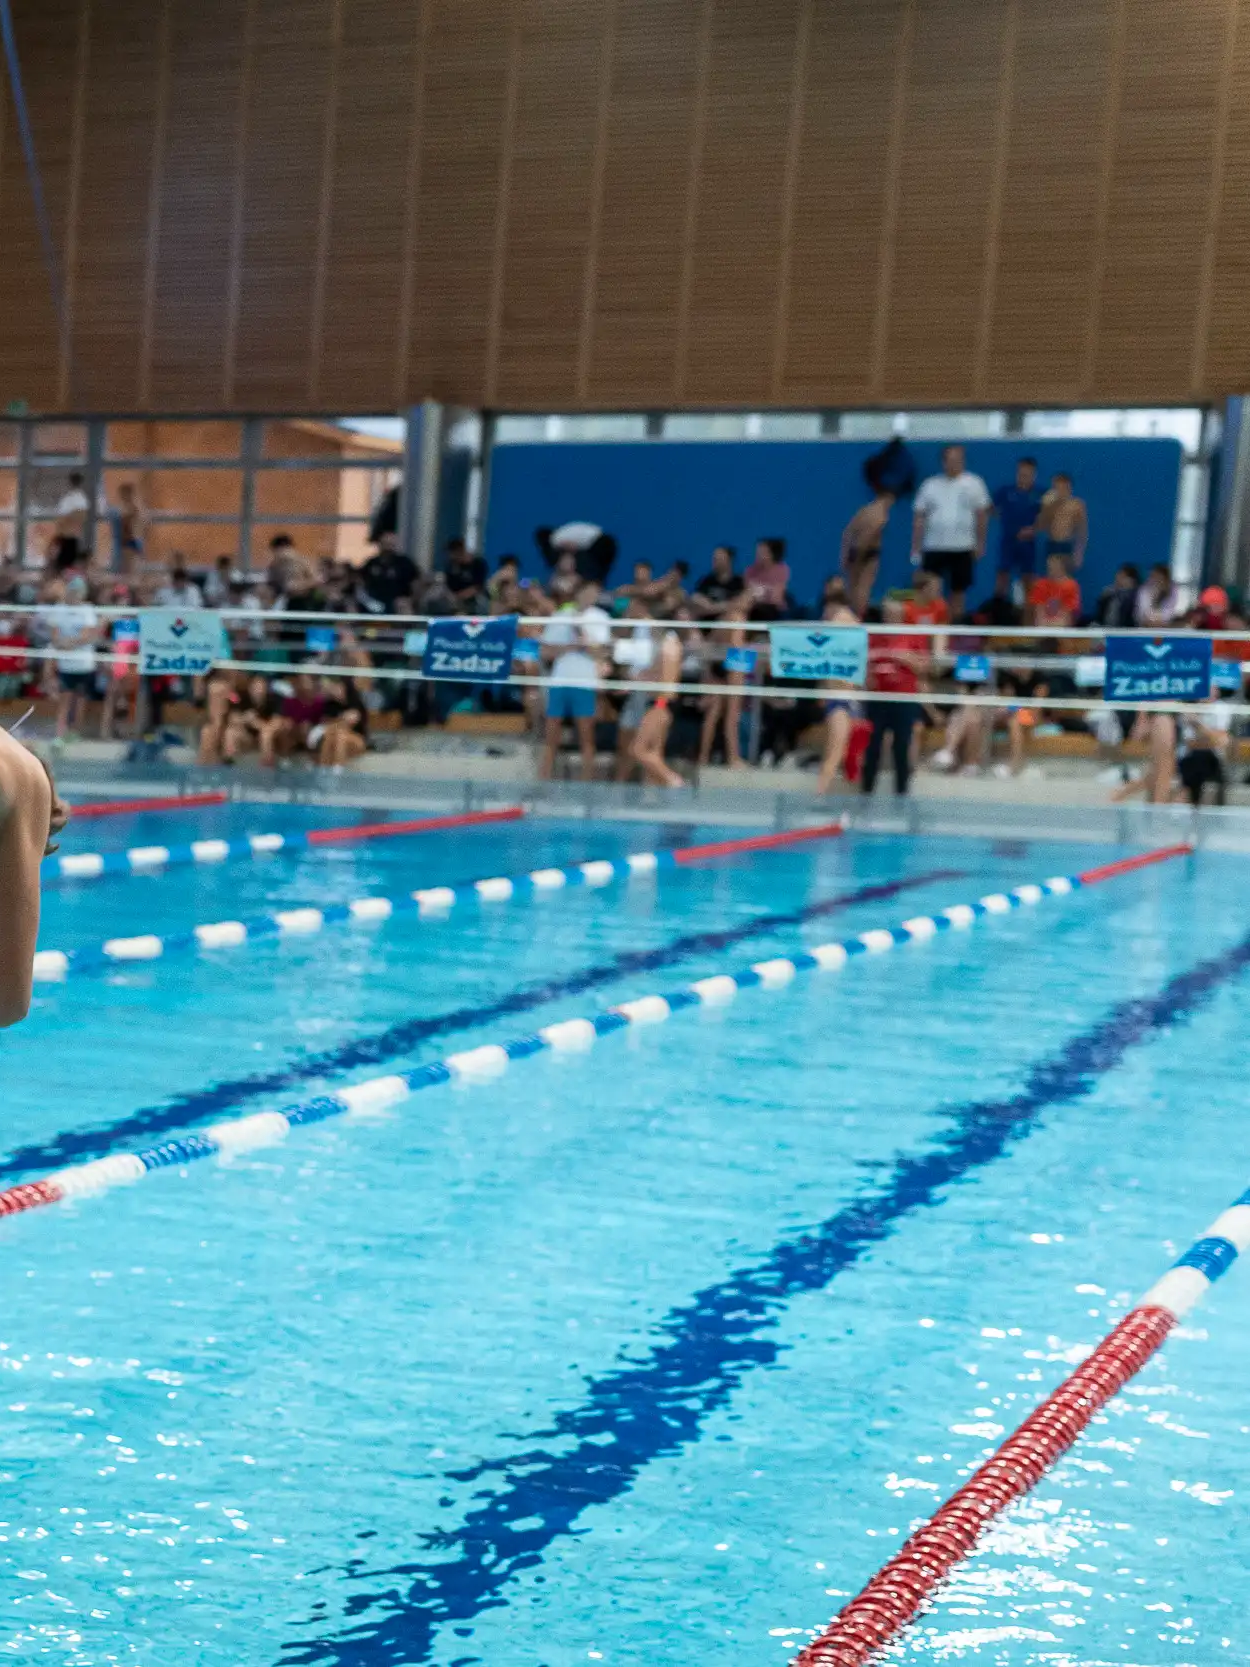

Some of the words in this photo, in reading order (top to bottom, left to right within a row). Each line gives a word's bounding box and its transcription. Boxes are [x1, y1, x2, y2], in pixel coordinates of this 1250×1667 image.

[146, 653, 211, 670] Zadar
[430, 651, 505, 673] Zadar
[778, 660, 859, 678] Zadar
[1111, 675, 1201, 697] Zadar
